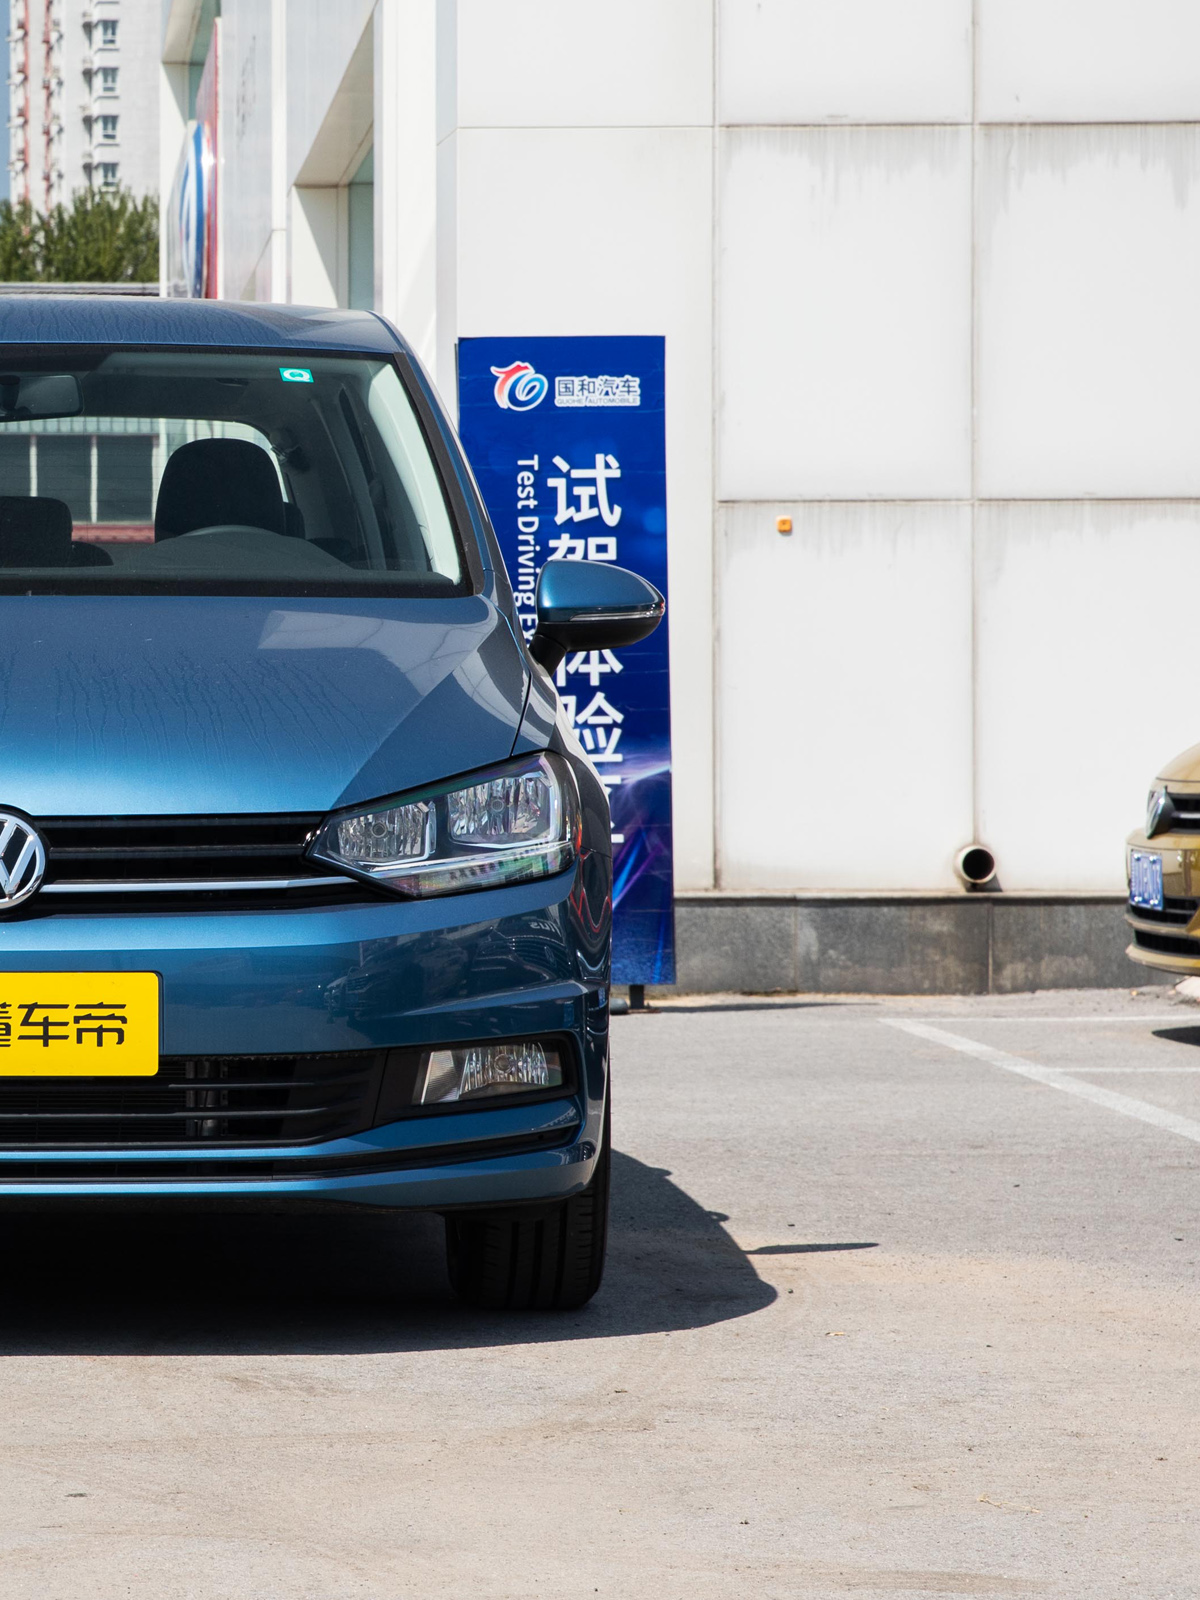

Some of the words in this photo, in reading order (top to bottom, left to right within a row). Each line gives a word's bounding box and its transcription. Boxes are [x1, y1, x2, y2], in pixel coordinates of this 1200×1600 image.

[557, 378, 638, 397] 国和汽车
[517, 454, 539, 509] Test
[513, 516, 541, 607] Driving
